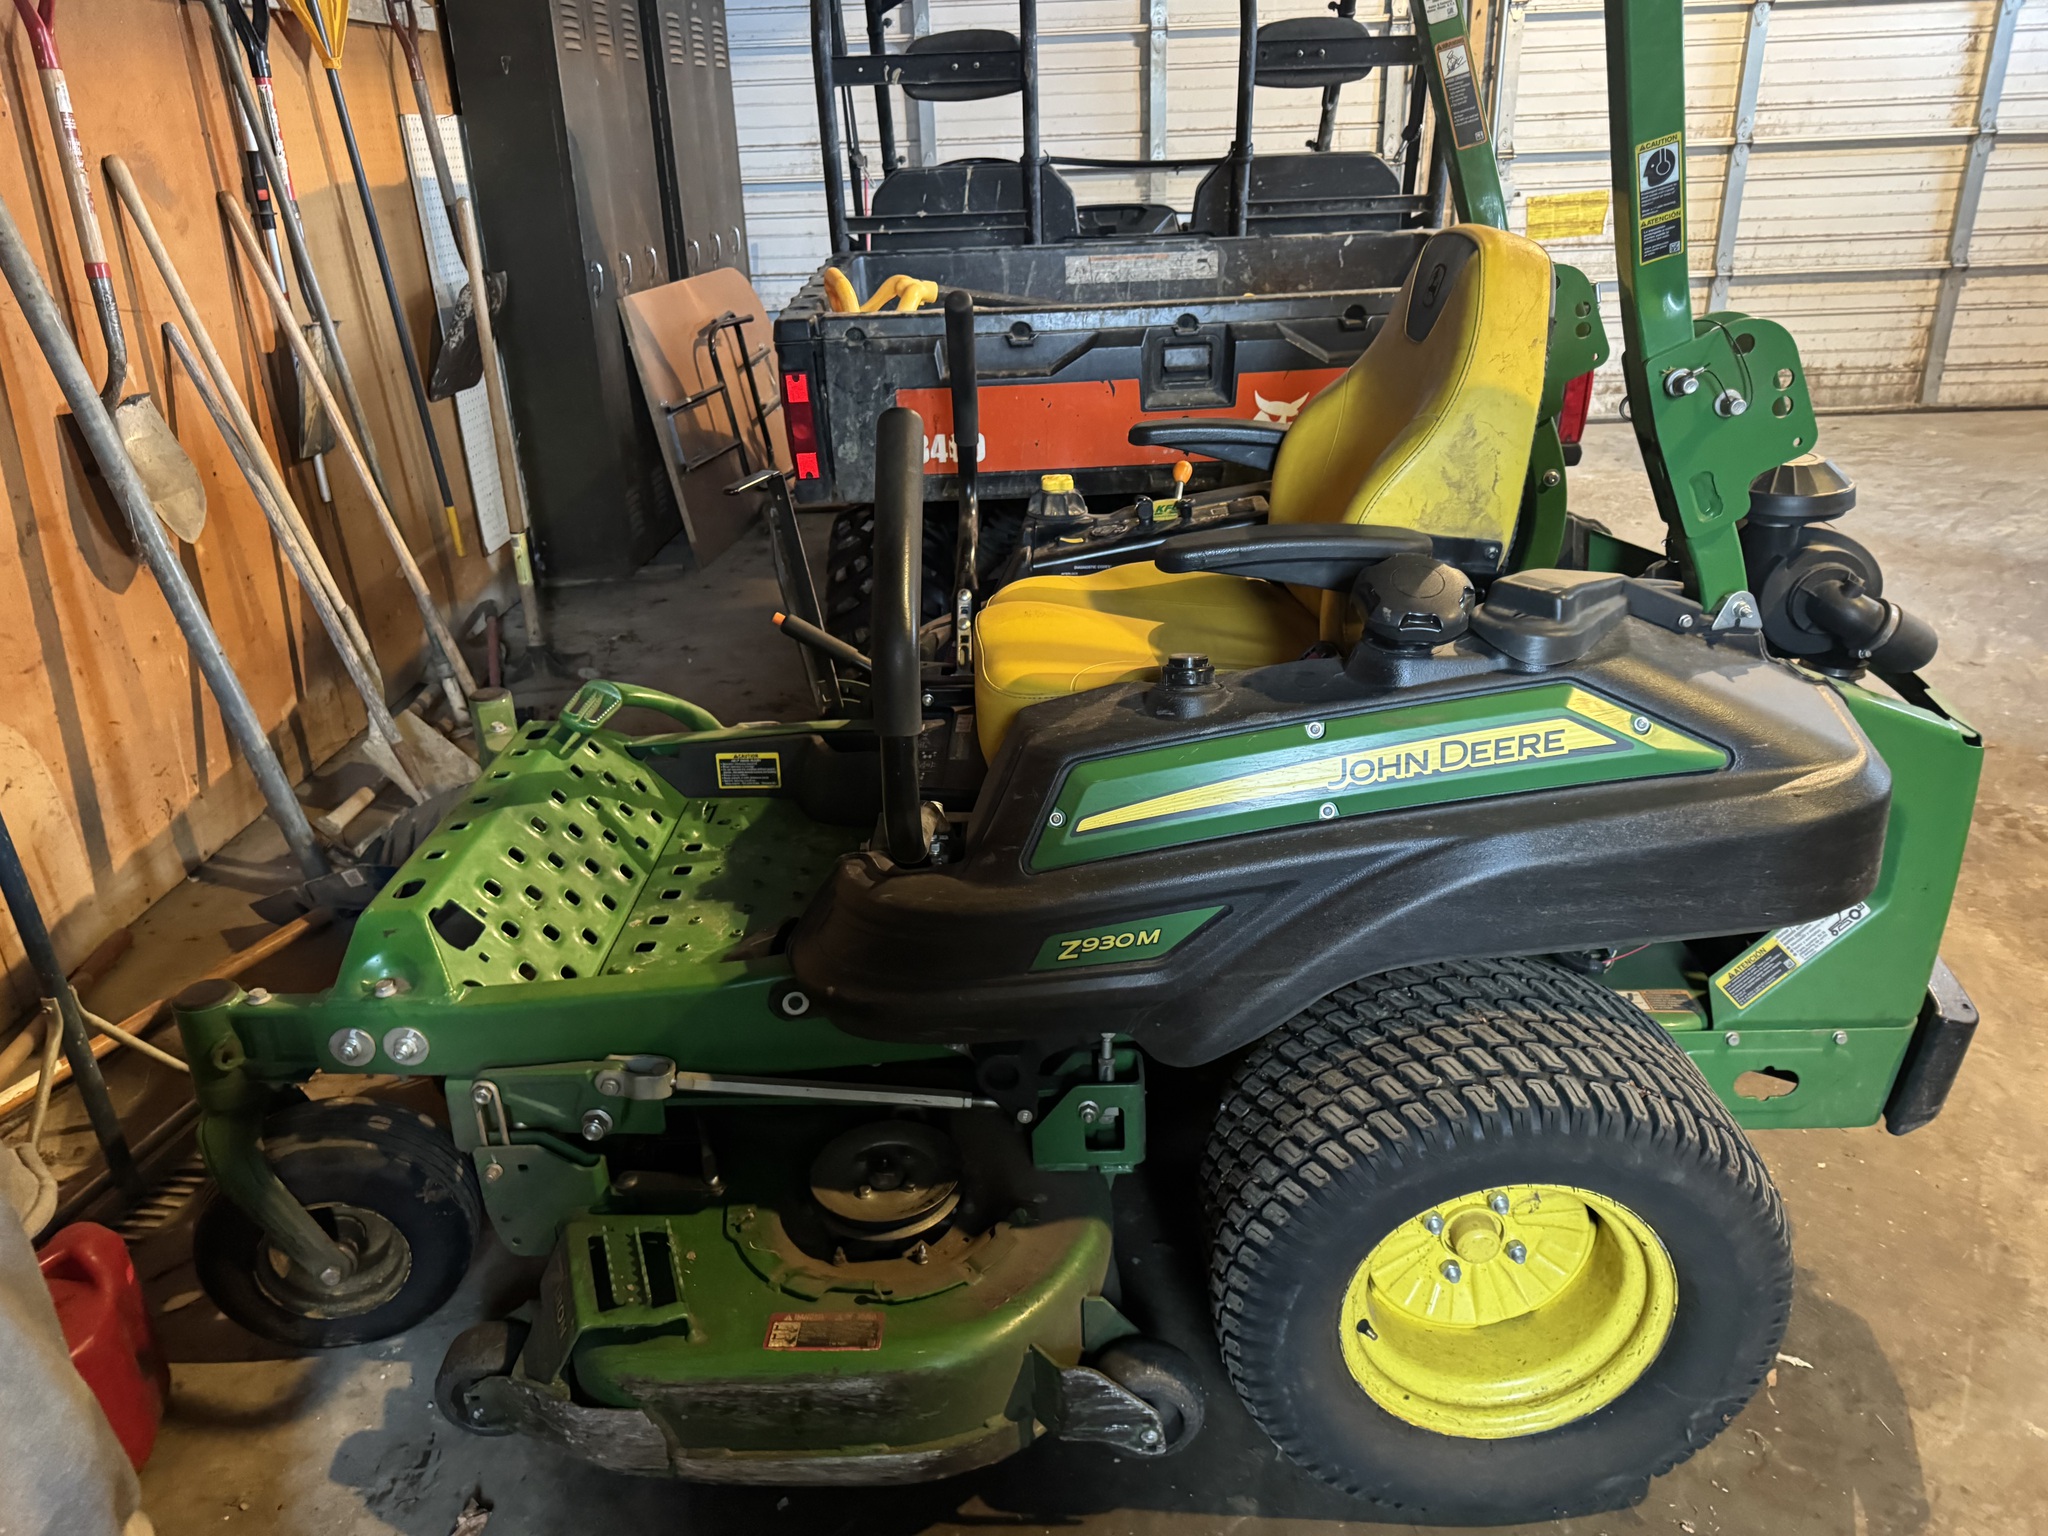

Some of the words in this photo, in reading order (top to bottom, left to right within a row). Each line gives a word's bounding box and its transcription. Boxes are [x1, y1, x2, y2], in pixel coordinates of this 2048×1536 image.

[1646, 134, 1678, 149] CAUTION
[1646, 210, 1681, 226] ATENCIÓN
[1327, 749, 1429, 787] JOHN
[1440, 729, 1566, 769] DEERE
[1057, 929, 1161, 960] Z930M
[1733, 946, 1767, 975] ATENCIÓN
